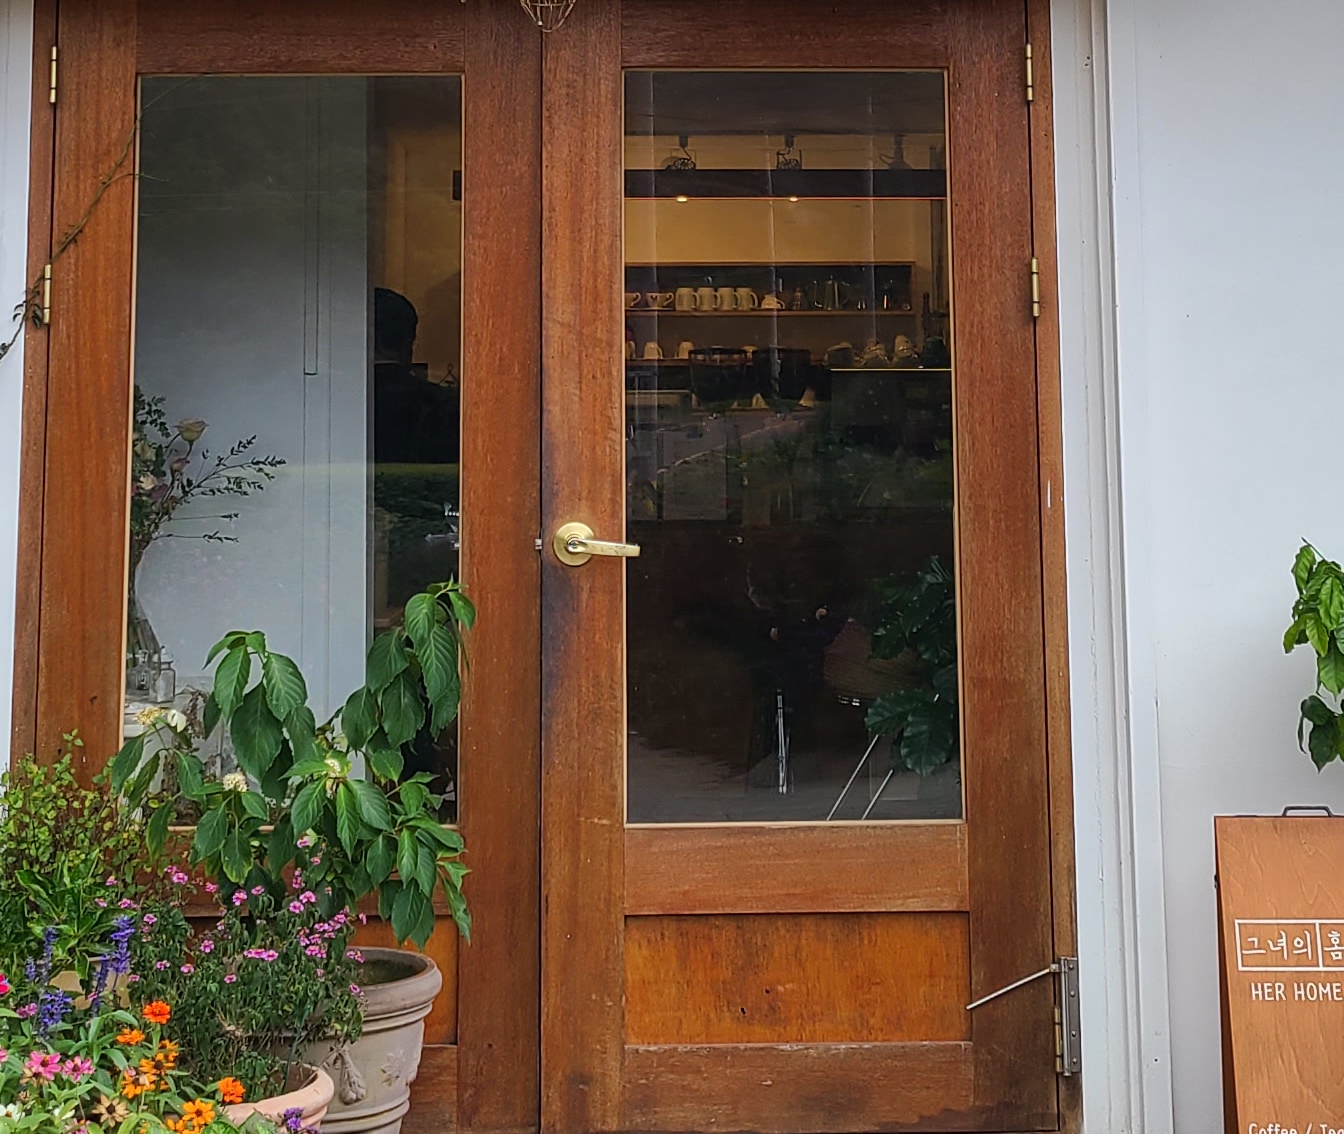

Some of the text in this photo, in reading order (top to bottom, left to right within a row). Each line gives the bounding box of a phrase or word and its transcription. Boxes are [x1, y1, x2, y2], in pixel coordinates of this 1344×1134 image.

[1241, 930, 1312, 961] 그녀의
[1251, 982, 1287, 1001] HER
[1293, 982, 1344, 1001] HOME
